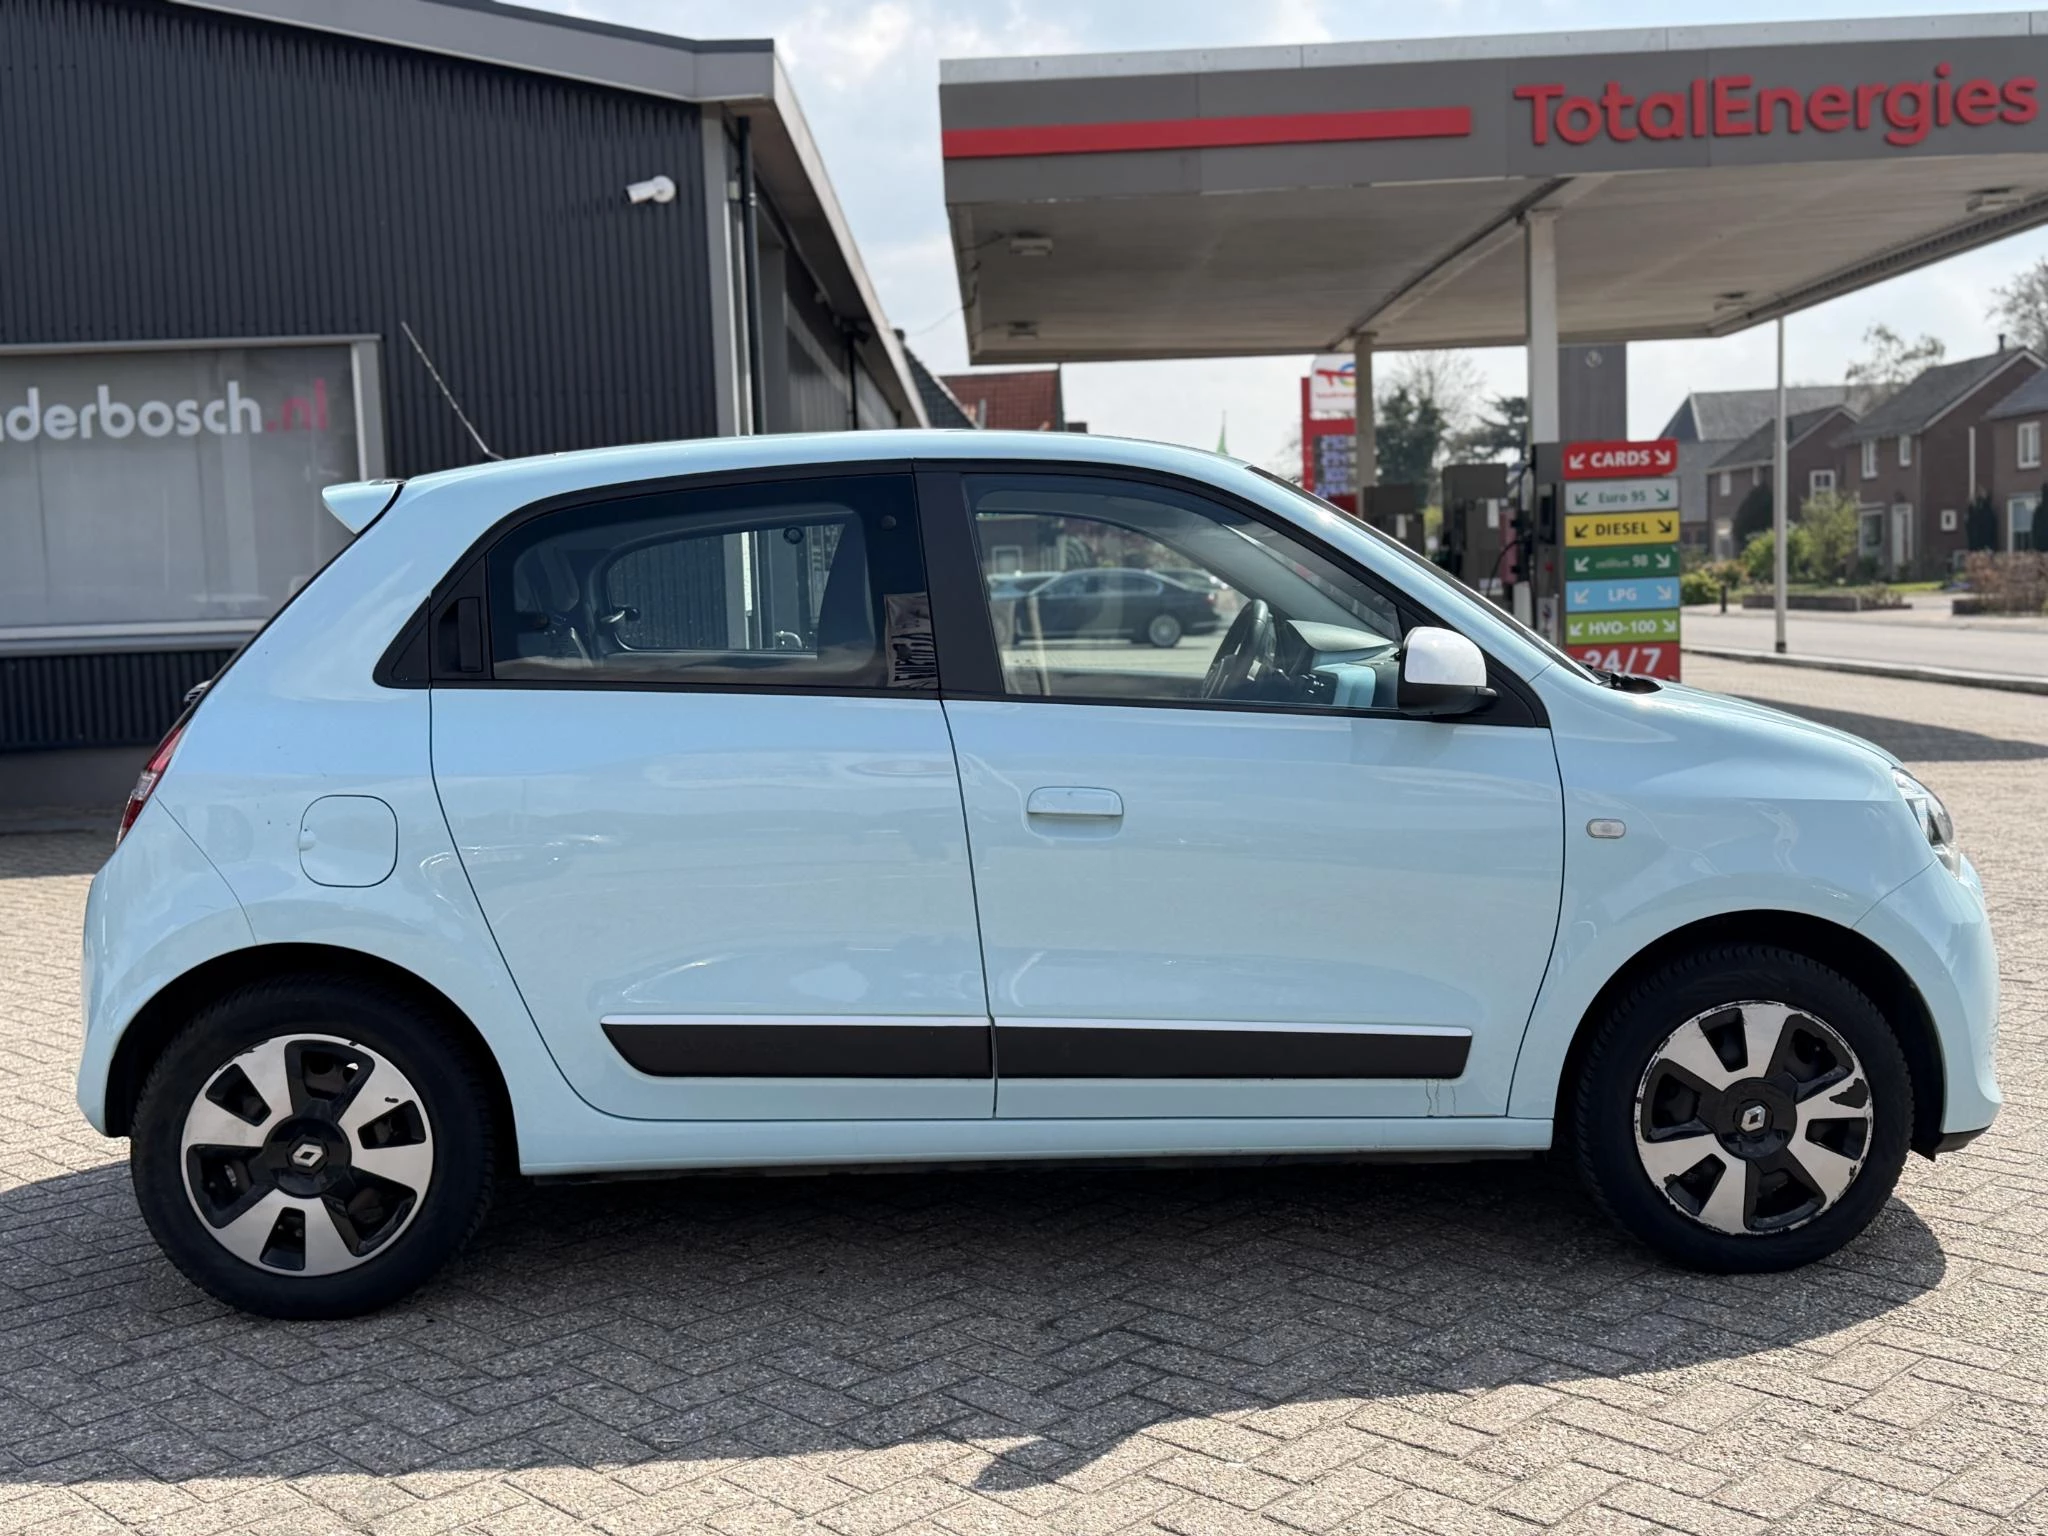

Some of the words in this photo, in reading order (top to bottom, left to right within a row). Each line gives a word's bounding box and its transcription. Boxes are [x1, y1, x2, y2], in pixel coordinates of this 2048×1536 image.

[1514, 62, 2040, 147] TotalEnergies
[1589, 450, 1652, 469] CARDS
[1598, 492, 1629, 504] Euro
[1631, 489, 1647, 502] 95
[1595, 521, 1649, 536] DIESEL
[1607, 587, 1638, 602] LPG
[1588, 620, 1658, 636] HVO-100
[1583, 647, 1662, 674] 24/7
